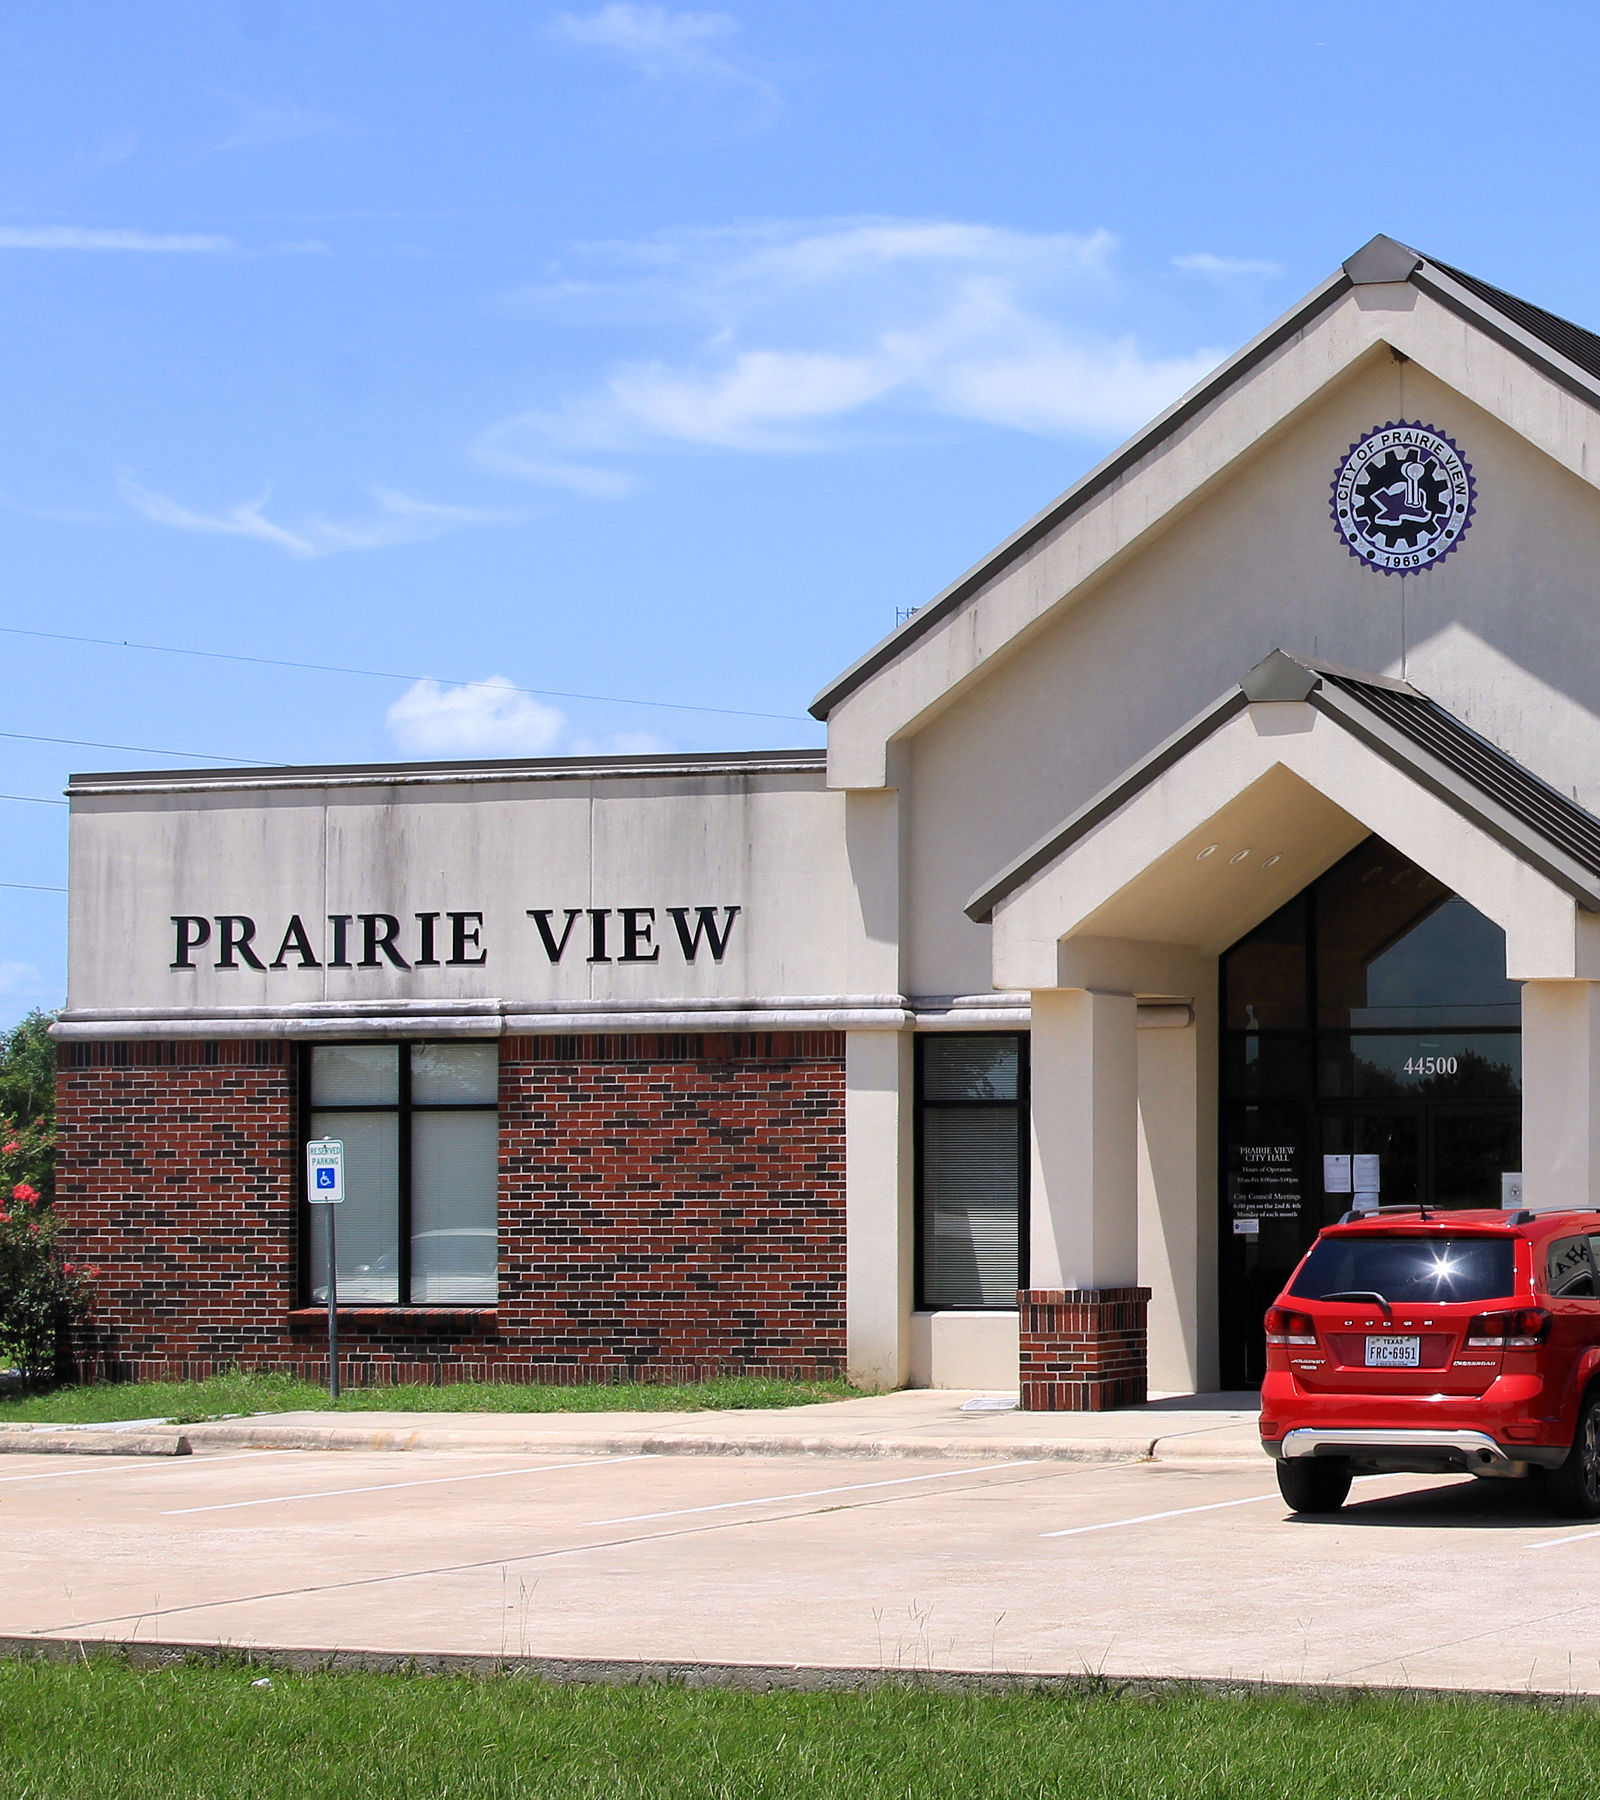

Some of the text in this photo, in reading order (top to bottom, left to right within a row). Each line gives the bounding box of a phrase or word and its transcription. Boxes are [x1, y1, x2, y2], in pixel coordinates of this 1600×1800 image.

[1338, 431, 1466, 500] CITY OF PRAIRIE VIEW
[1385, 555, 1420, 567] 1969
[169, 906, 742, 971] PRAIRIE VIEW
[1404, 1057, 1458, 1074] 44500
[310, 1147, 341, 1155] RESERVED
